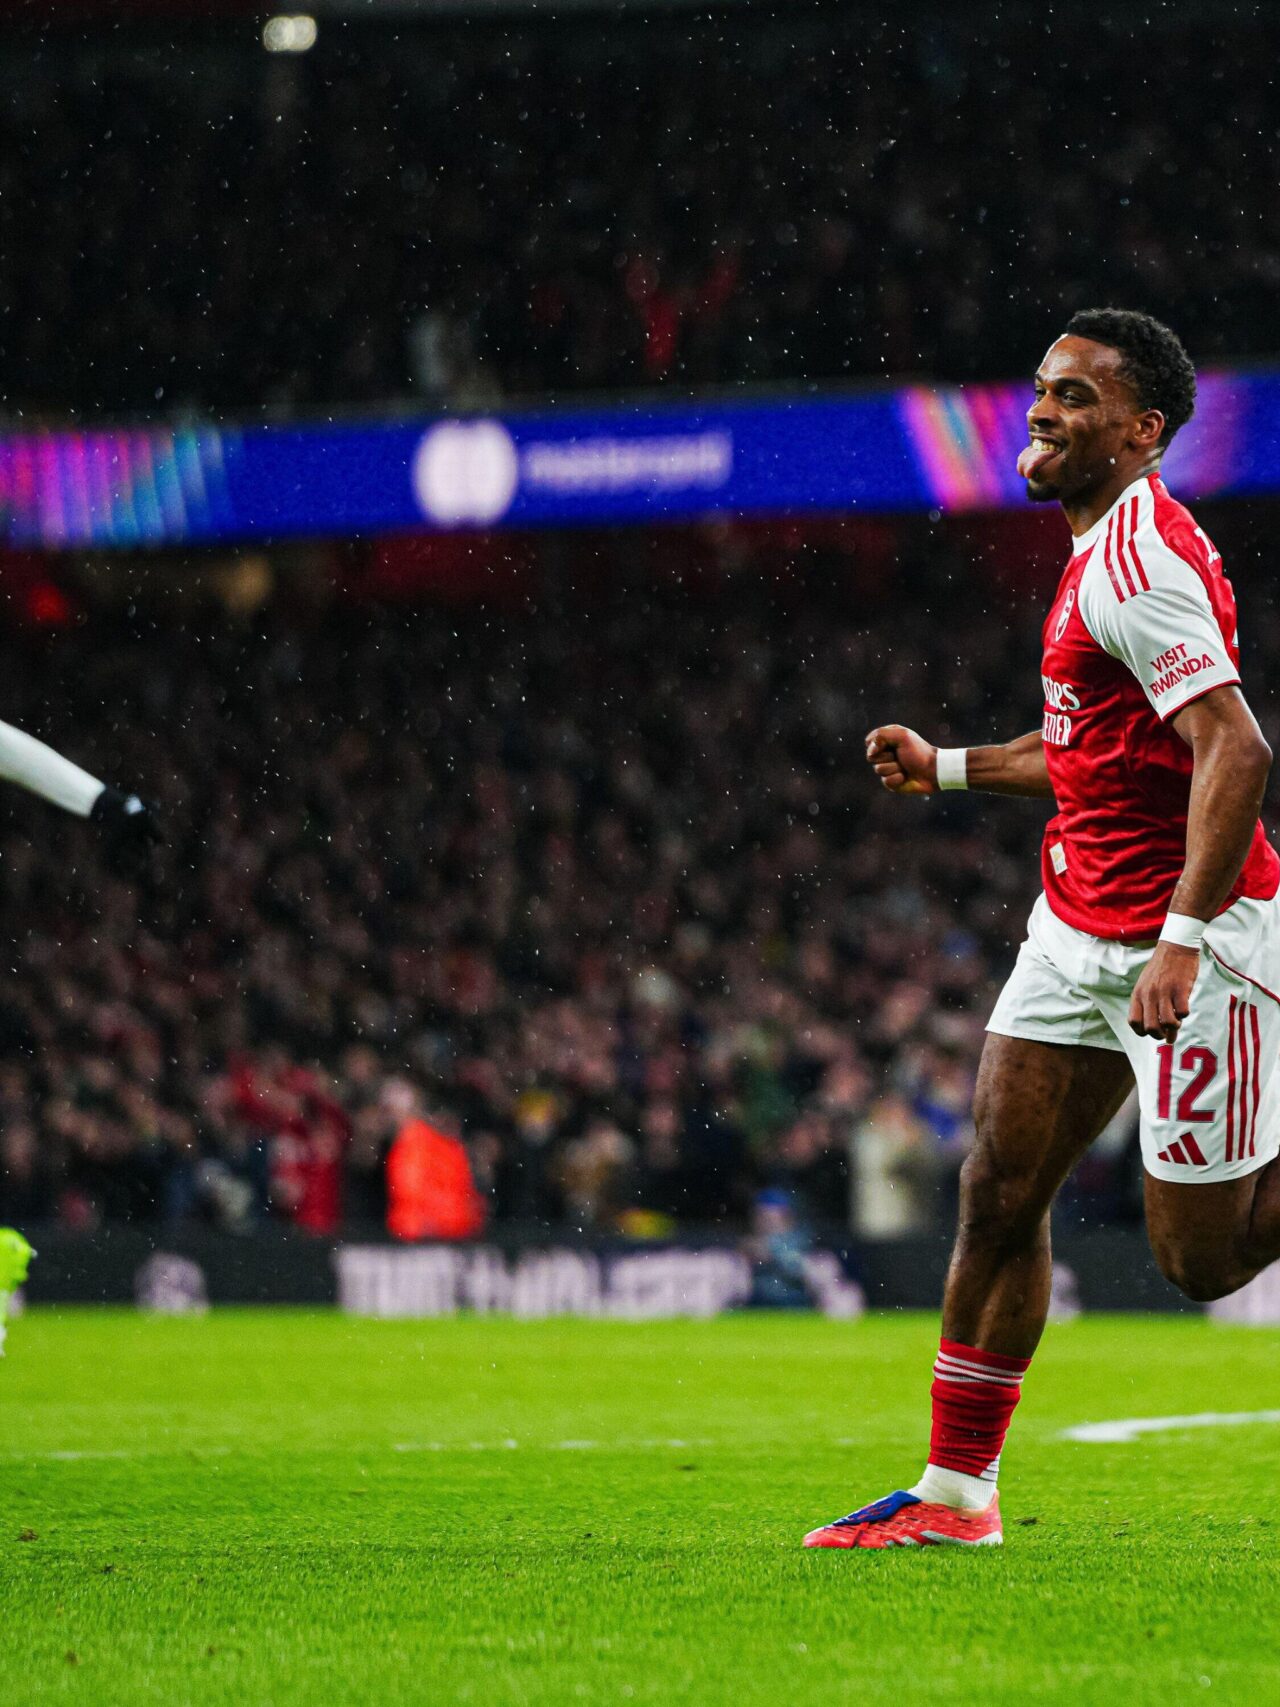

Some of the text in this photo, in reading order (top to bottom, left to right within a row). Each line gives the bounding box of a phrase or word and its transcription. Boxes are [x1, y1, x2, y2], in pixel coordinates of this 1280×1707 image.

[1149, 653, 1216, 698] RWANDA
[1150, 643, 1187, 673] VISIT
[1042, 712, 1072, 746] ETTER
[1157, 1044, 1218, 1123] 12
